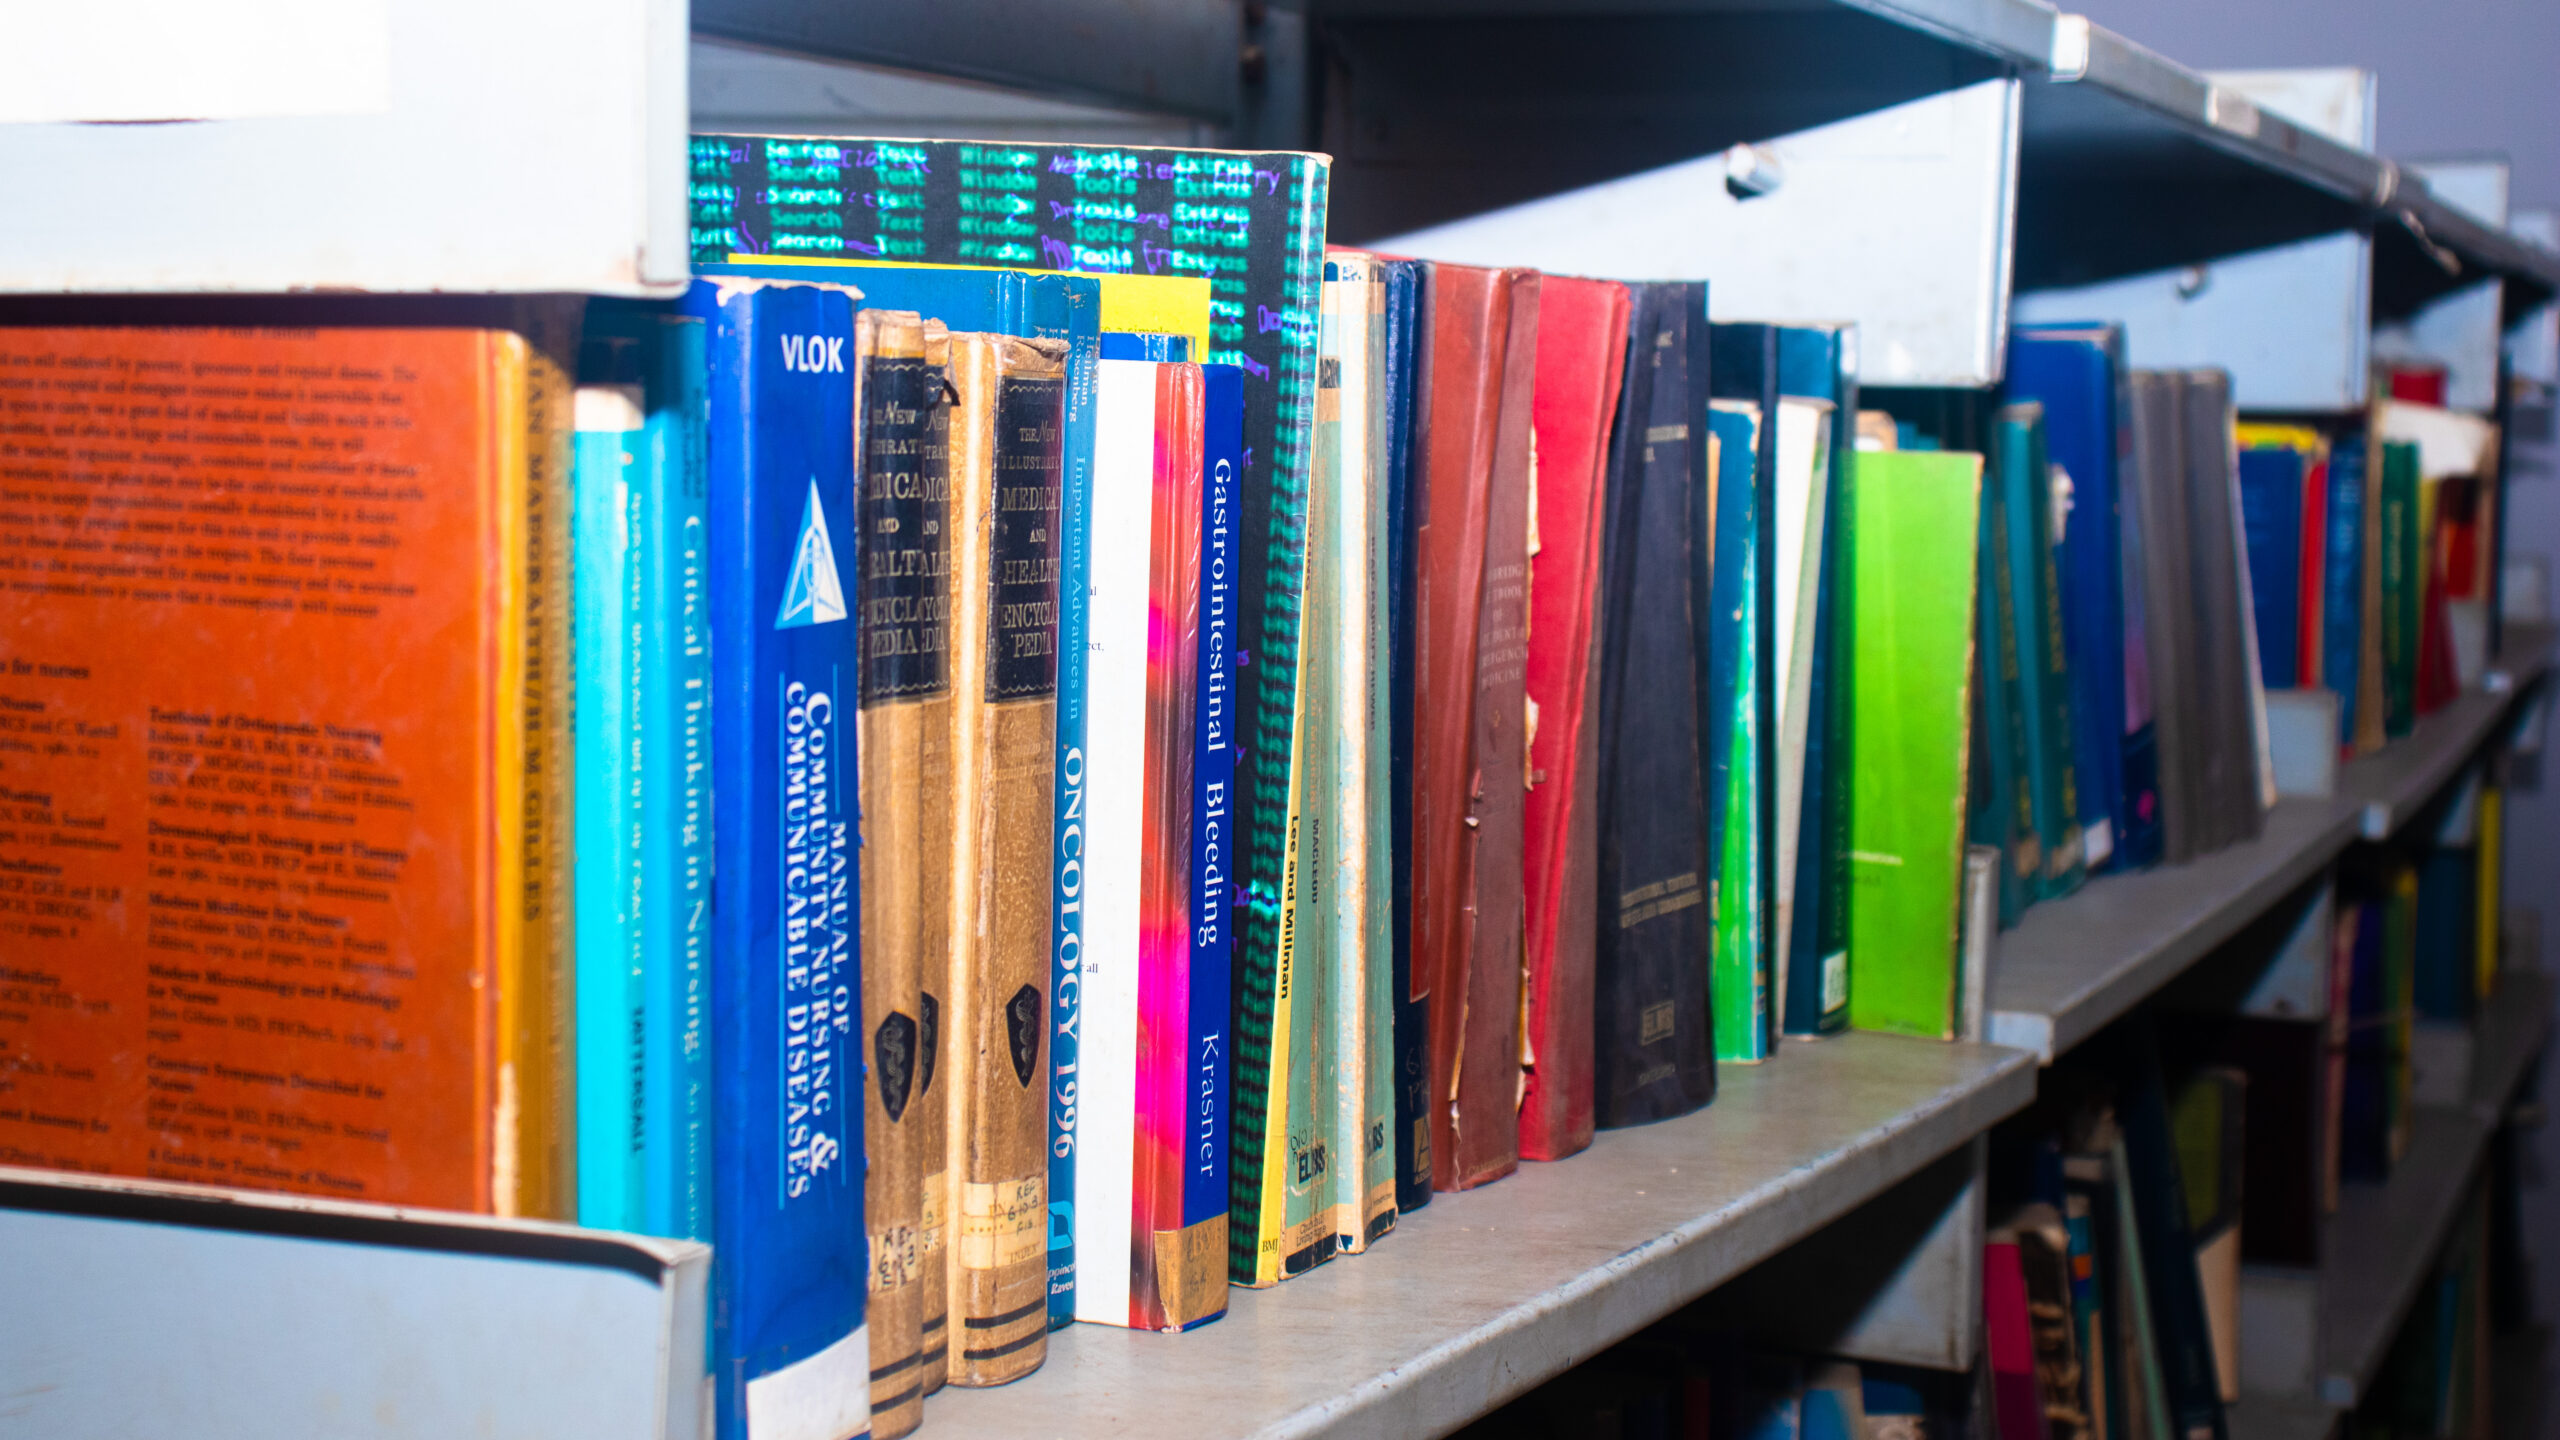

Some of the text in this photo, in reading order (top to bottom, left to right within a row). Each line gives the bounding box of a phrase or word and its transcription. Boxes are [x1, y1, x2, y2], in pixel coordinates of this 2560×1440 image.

[767, 160, 1252, 198] Search Text Window Tools Extras
[770, 208, 1250, 248] Search Text Window Tools Extras
[781, 335, 844, 373] VLOK
[1068, 336, 1085, 422] Rosenberg
[1019, 427, 1039, 442] THE
[1029, 528, 1046, 542] AND
[683, 515, 703, 656] Critical
[1070, 457, 1086, 722] Important Advances in
[1013, 632, 1052, 657] PEDIA
[682, 679, 703, 848] Thinking
[1198, 458, 1232, 1178] Gastrointestinal Bleeding Krasner
[1311, 818, 1320, 904] MACLEOD
[686, 855, 699, 891] in
[1280, 815, 1299, 1000] Lee and Millman
[786, 682, 810, 1199] COMMUNICABLE DISEASES
[807, 693, 838, 1177] COMMUNITY NURSING &
[829, 821, 850, 1034] MANUAL OF
[1054, 746, 1083, 1160] ONCOLOGY 1996
[630, 1004, 646, 1154] TATTERSALL
[1051, 1280, 1074, 1295] Raven
[1262, 1238, 1278, 1254] BMJ
